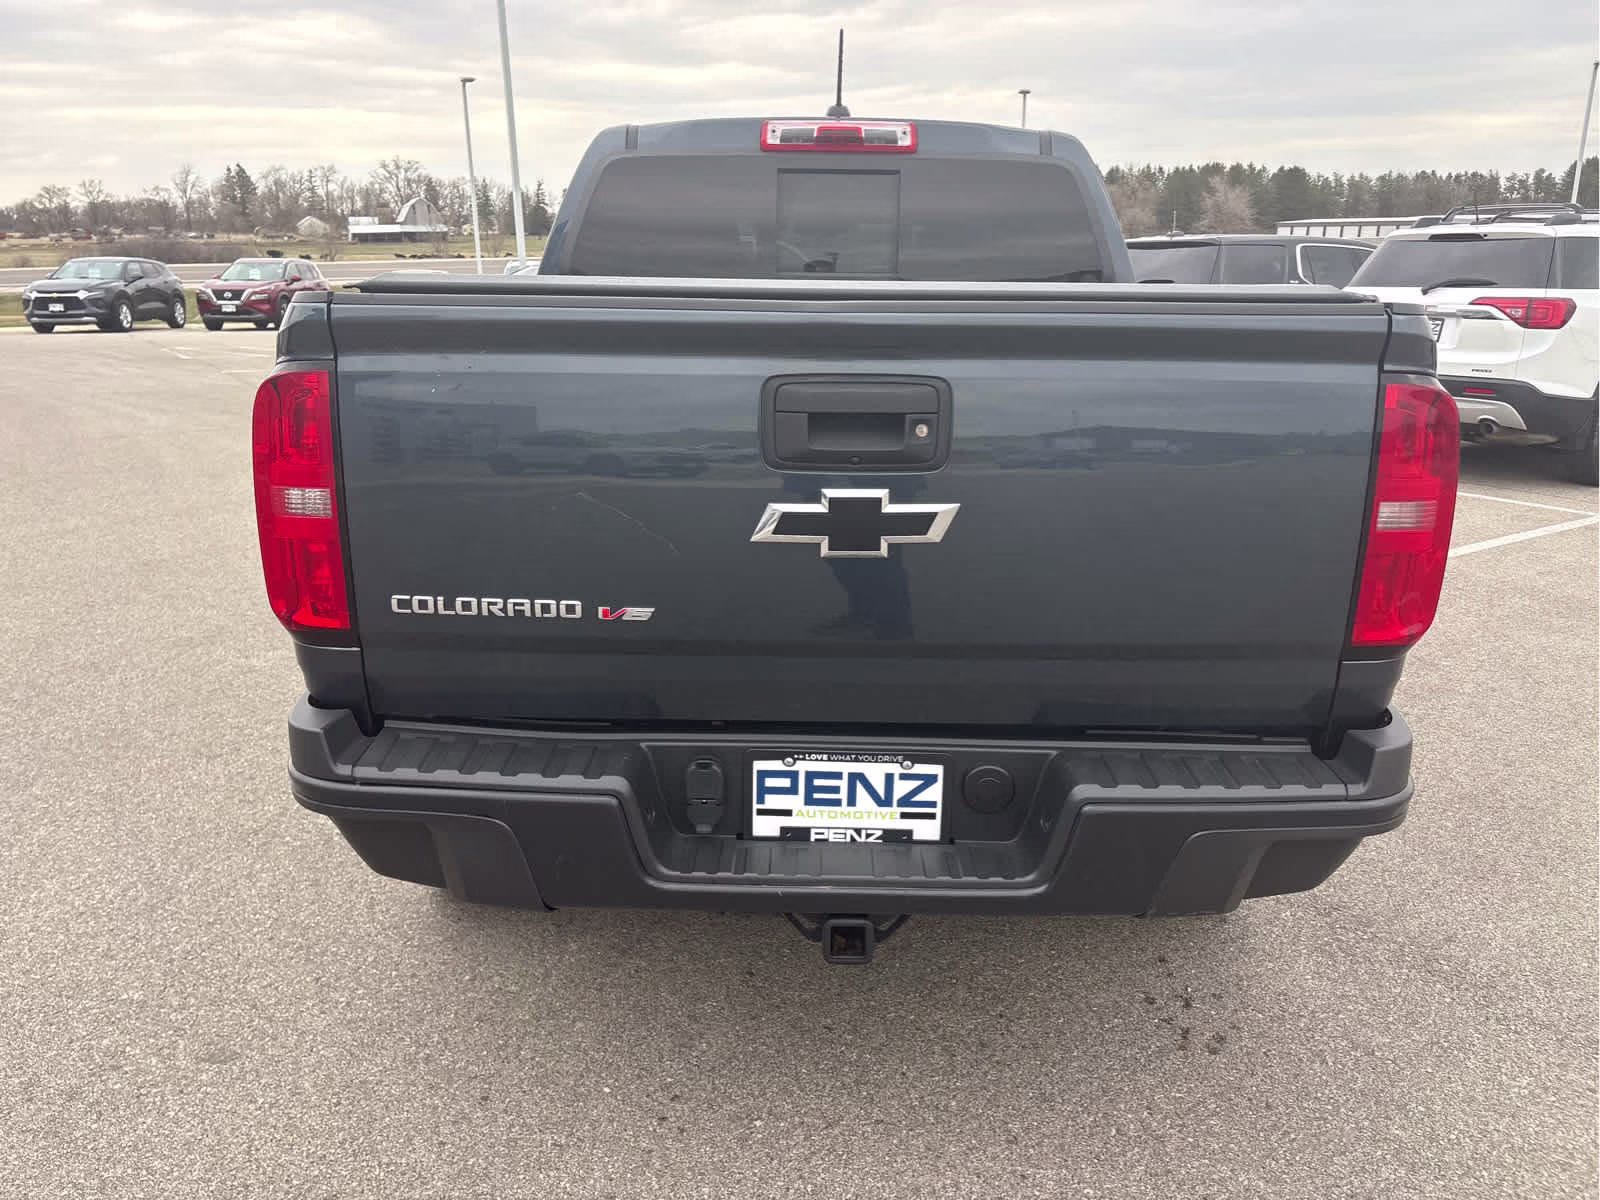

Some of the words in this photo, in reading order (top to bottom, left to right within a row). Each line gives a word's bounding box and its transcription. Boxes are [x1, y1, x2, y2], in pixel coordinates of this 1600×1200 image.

[391, 594, 583, 619] COLORADO
[597, 606, 656, 621] V6
[805, 753, 828, 761] LOVE
[829, 754, 856, 762] WHAT
[878, 755, 904, 763] DRIVE
[756, 769, 939, 808] PENZ
[795, 809, 898, 820] AUTOMOTIVE
[810, 827, 884, 843] PENZ
